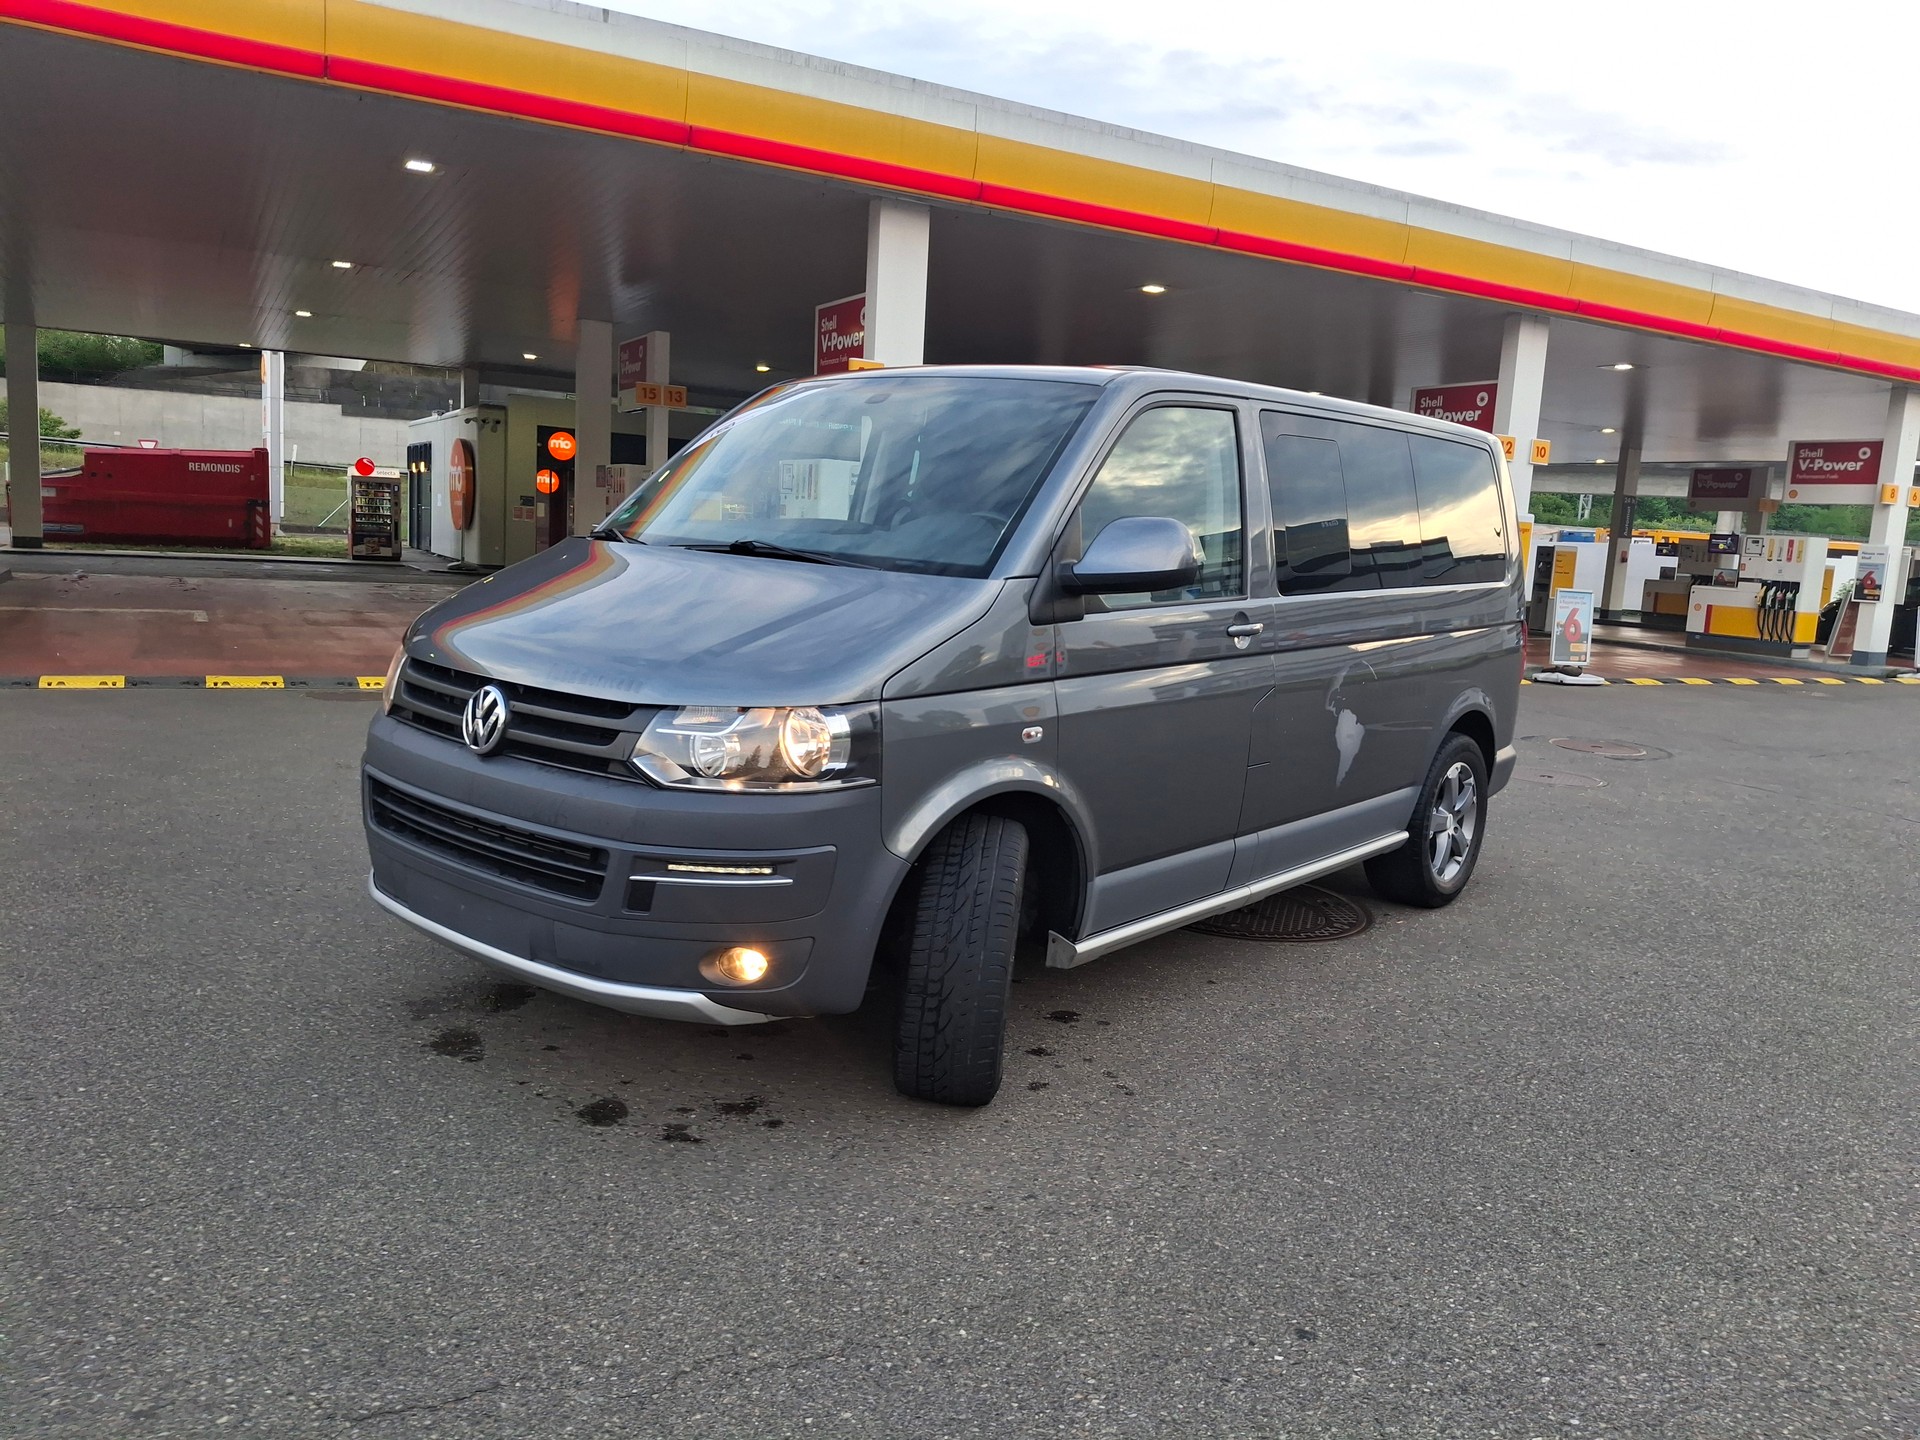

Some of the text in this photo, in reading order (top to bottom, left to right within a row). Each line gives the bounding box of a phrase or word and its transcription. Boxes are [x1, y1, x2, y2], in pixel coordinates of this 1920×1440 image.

[821, 315, 837, 332] Shell
[821, 331, 864, 353] V-Power
[641, 387, 657, 400] 15
[668, 390, 683, 403] 13
[1420, 396, 1443, 408] Shell
[550, 437, 572, 449] mio
[1536, 446, 1546, 458] 10
[1799, 448, 1823, 459] Shell
[189, 461, 241, 473] REMONDIS
[1799, 458, 1864, 472] V-Power
[1890, 488, 1896, 499] 8
[1912, 492, 1918, 502] 6
[1564, 607, 1581, 643] 6
